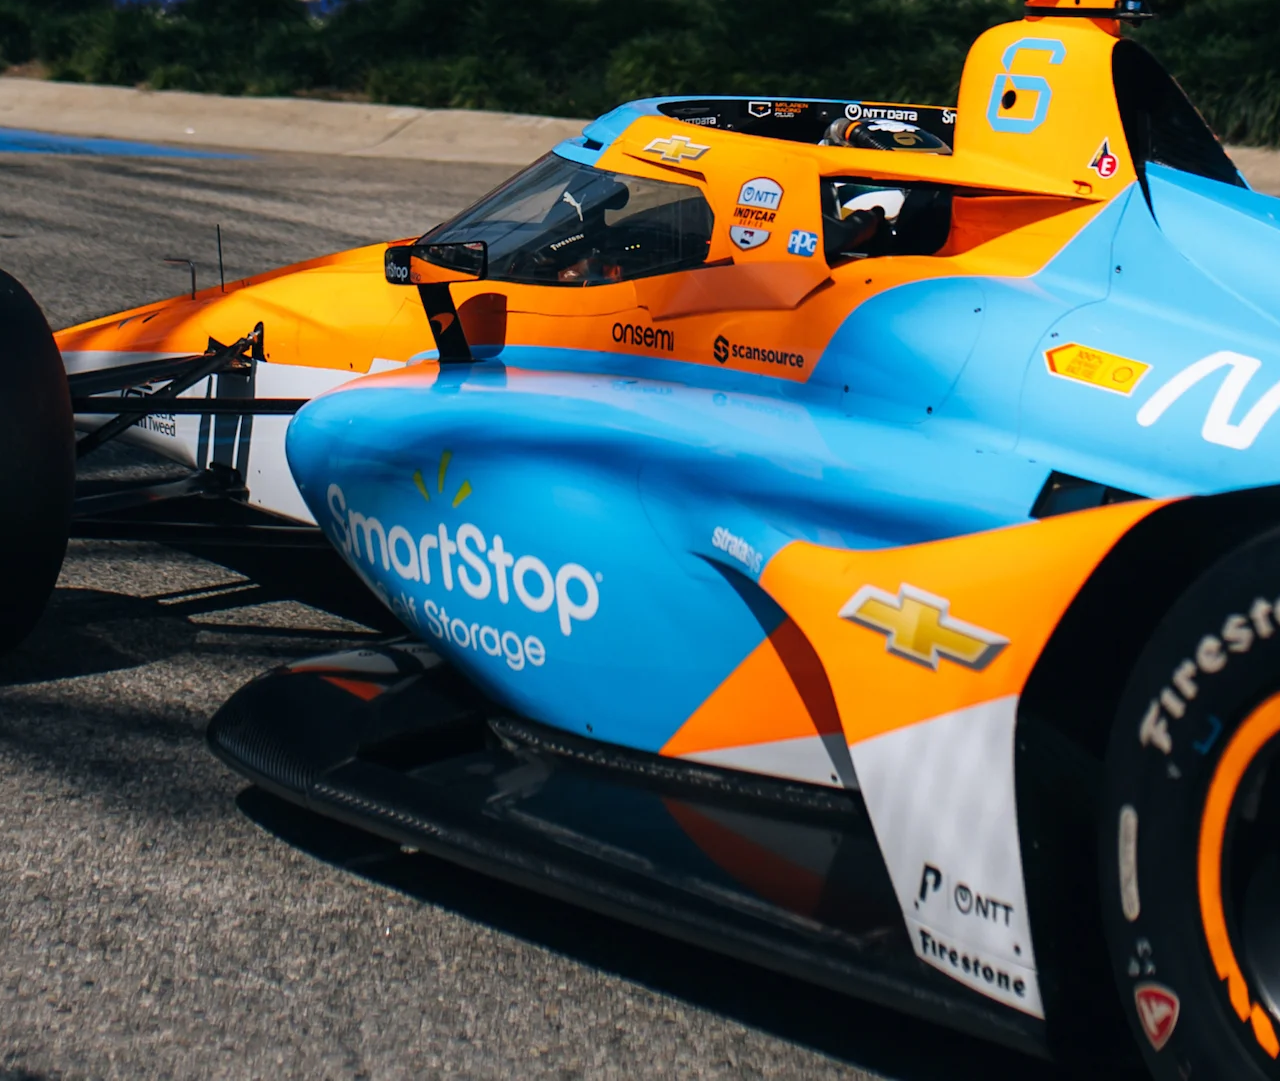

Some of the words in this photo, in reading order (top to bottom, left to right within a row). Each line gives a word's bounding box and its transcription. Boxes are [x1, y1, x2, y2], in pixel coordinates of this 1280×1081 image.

[986, 37, 1067, 134] 6
[754, 191, 778, 205] NTT
[733, 207, 776, 223] INDYCAR
[788, 232, 818, 254] PPG
[612, 322, 674, 351] onsemi
[732, 344, 804, 368] scansource
[423, 599, 546, 671] Storage
[975, 894, 1014, 927] NTT
[919, 928, 1026, 998] Firestone
